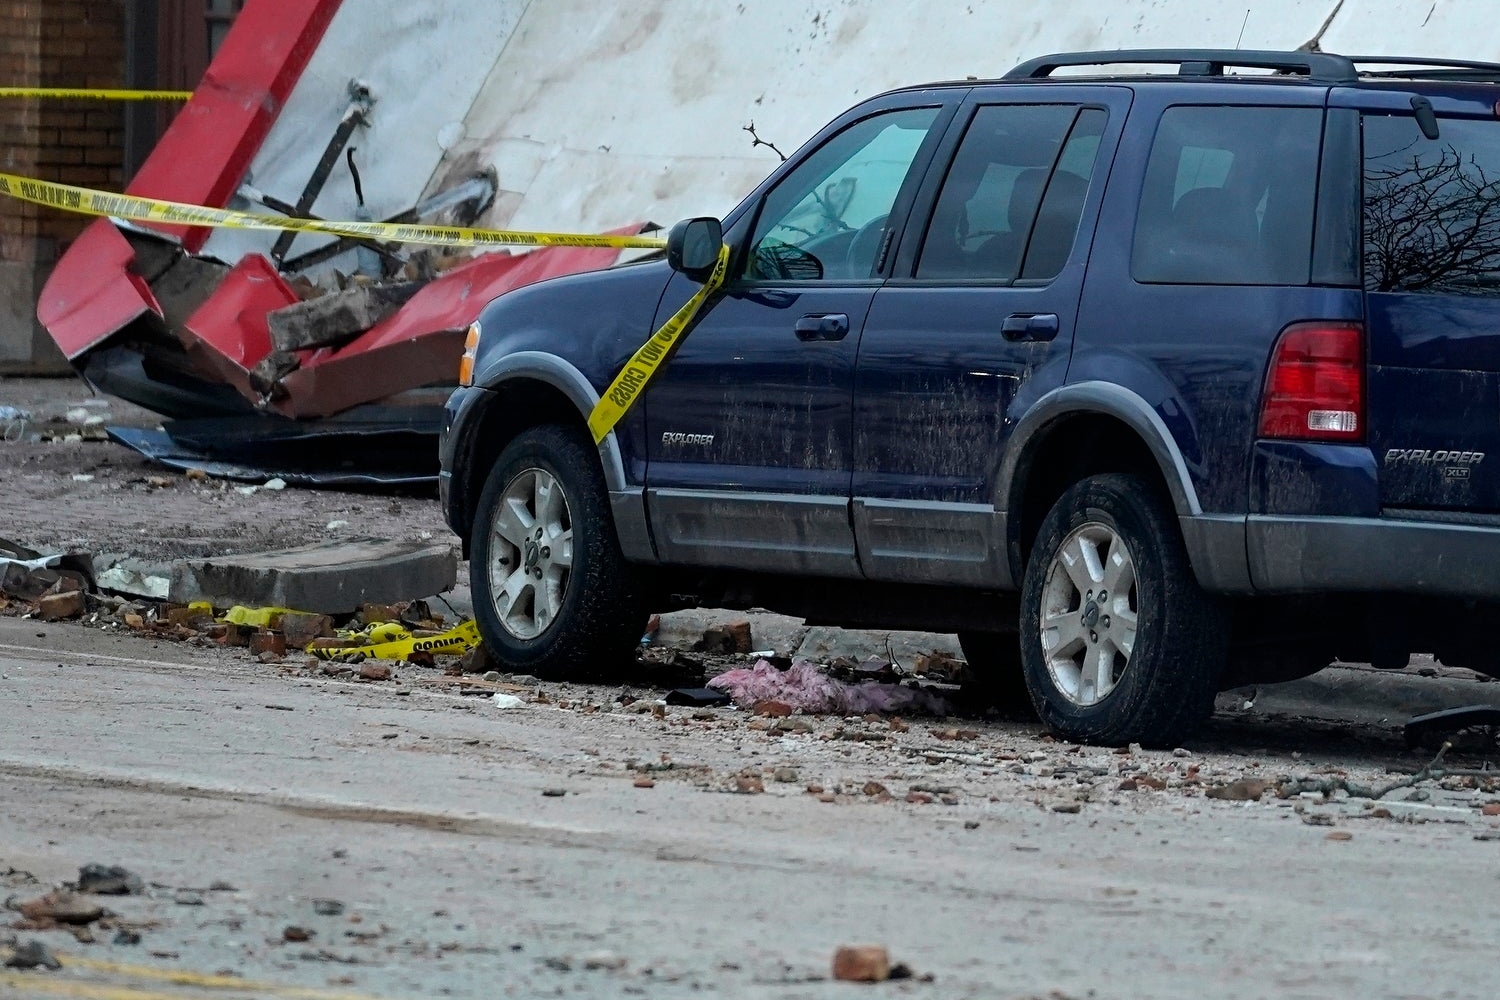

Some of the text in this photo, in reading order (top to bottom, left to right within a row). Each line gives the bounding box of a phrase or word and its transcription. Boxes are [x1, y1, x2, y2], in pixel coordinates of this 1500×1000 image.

[662, 432, 714, 446] EXPLORER
[1385, 448, 1485, 464] EXPLORER
[1447, 469, 1469, 477] XLT
